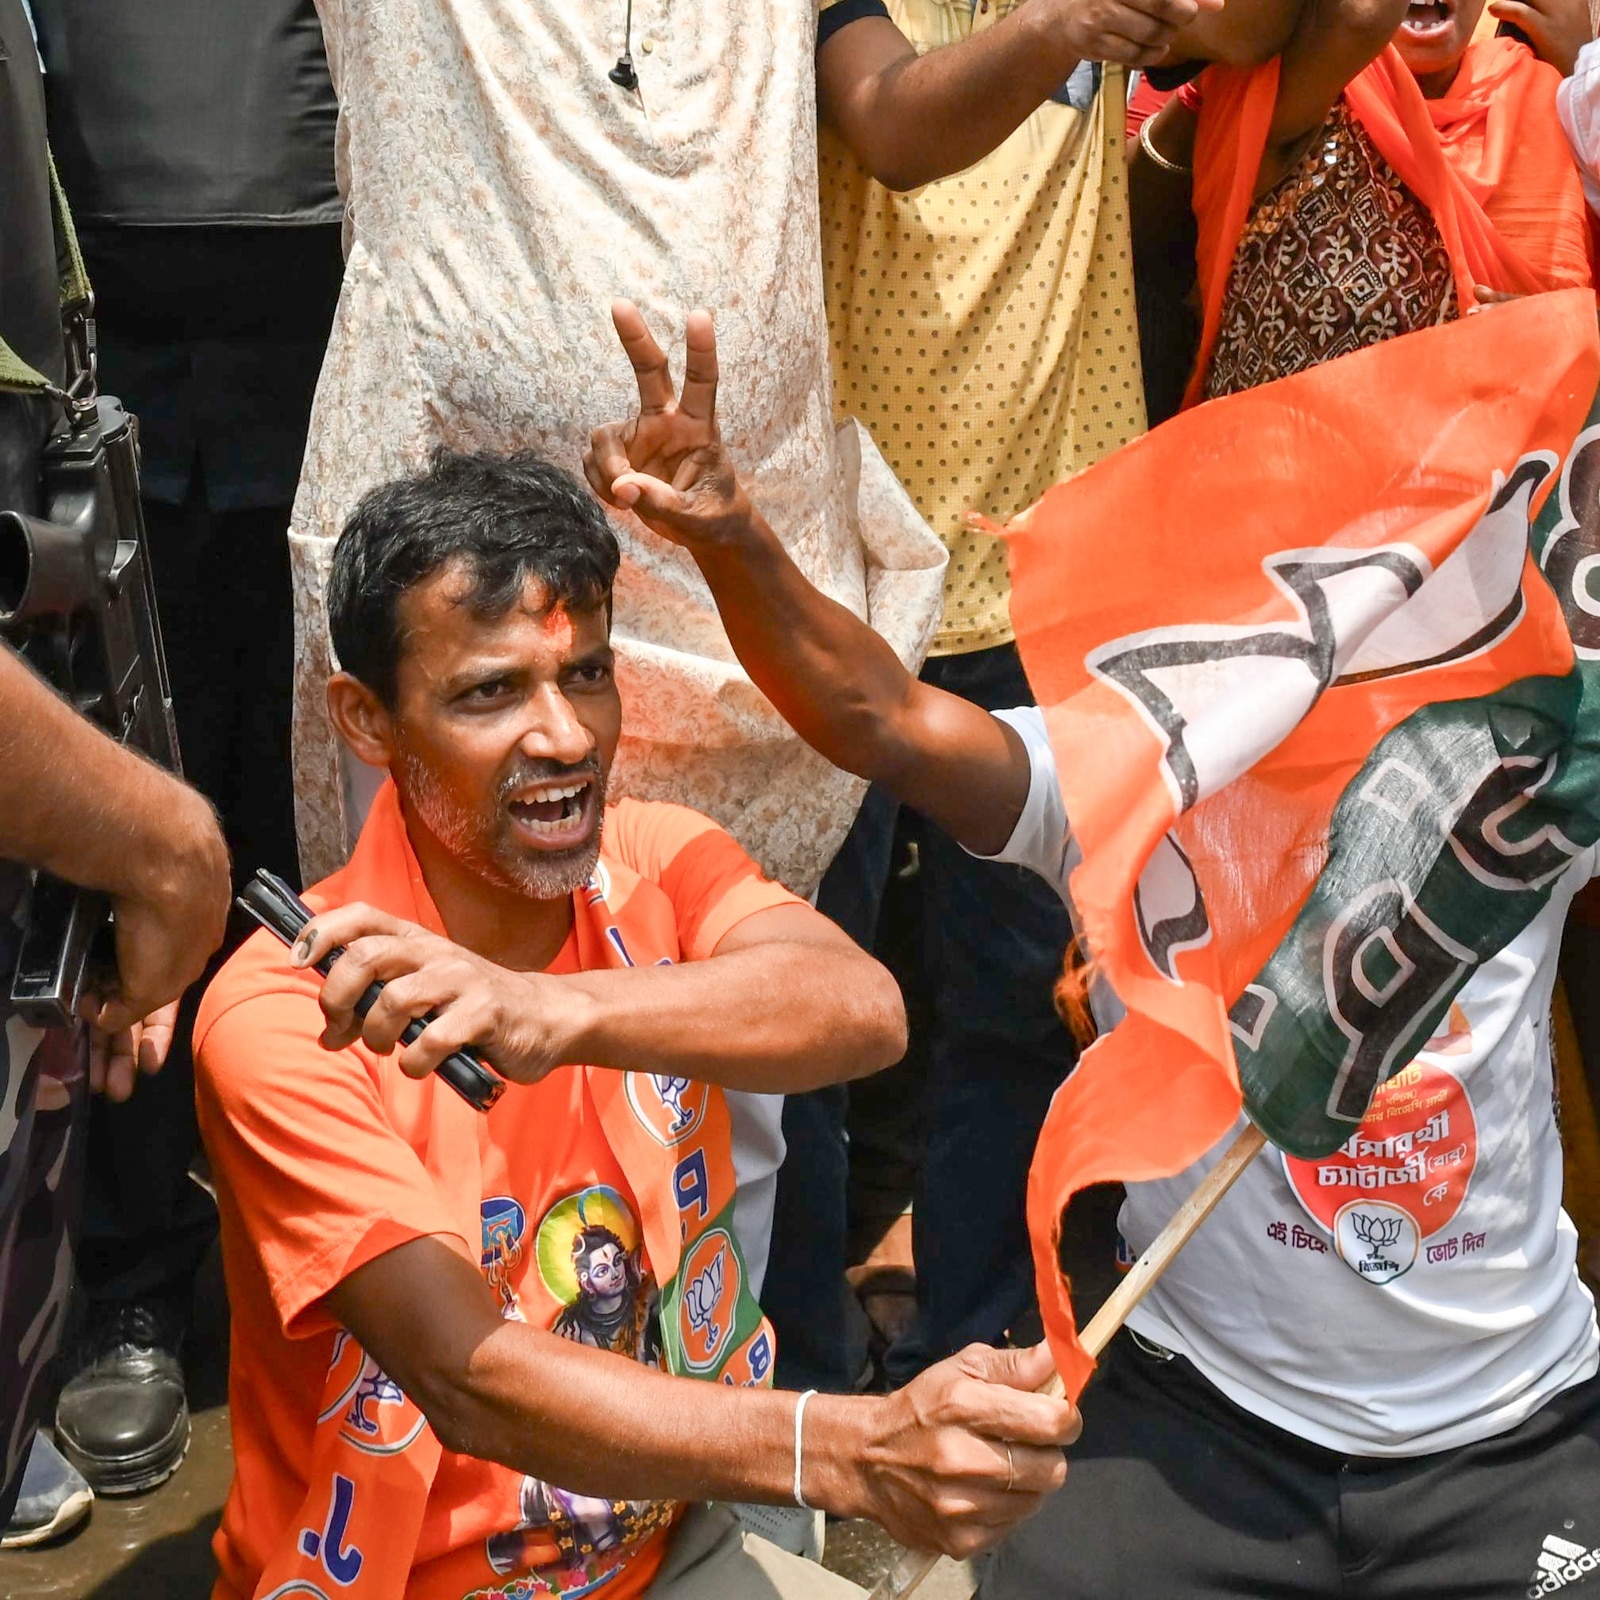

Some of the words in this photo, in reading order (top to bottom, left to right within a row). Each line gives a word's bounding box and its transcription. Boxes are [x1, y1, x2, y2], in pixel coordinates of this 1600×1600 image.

[1266, 1221, 1287, 1246] এই
[1426, 1237, 1458, 1265] ভোট
[1461, 1231, 1487, 1256] দিন
